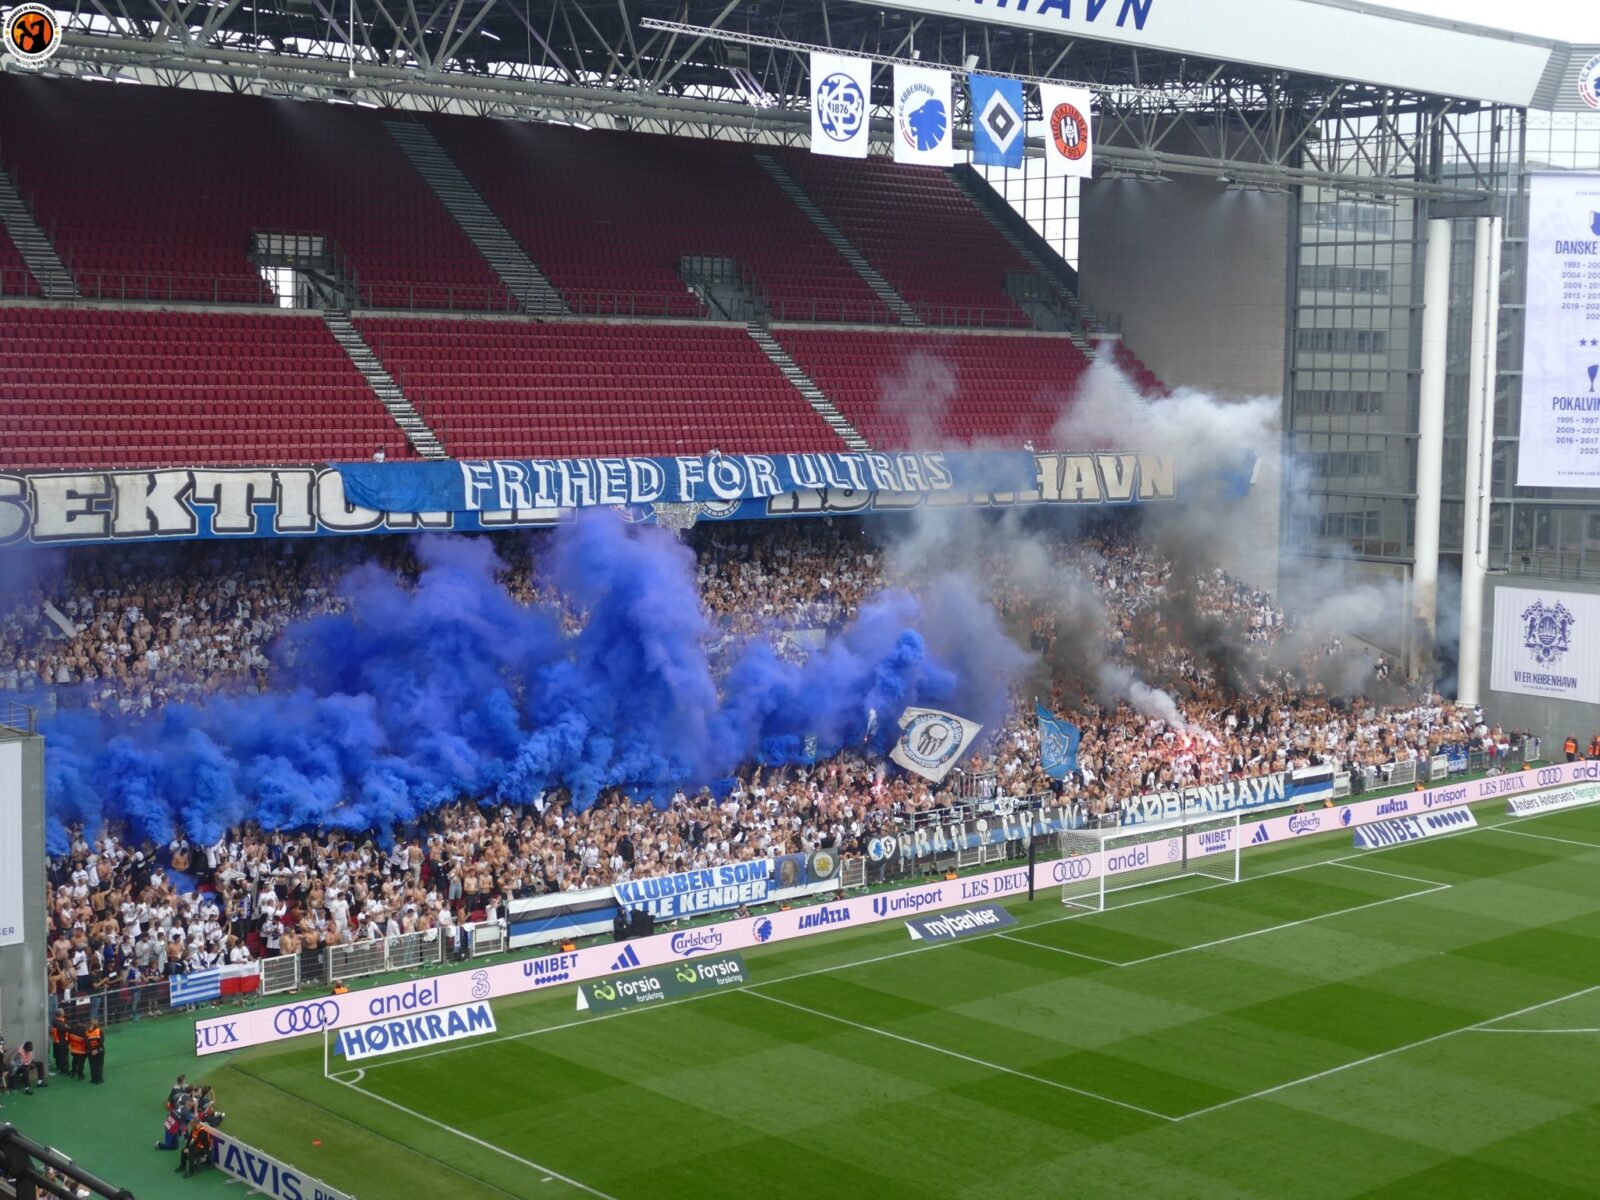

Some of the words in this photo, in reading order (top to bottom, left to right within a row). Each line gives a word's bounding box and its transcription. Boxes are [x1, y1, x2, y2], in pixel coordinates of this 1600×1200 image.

[900, 83, 936, 103] KØBENHAVN
[832, 103, 849, 114] 1876
[1052, 105, 1087, 142] BOLDKLUBBEN
[1064, 146, 1081, 158] 1903
[1555, 240, 1598, 255] DANSKE
[1553, 396, 1600, 411] POKALVI
[460, 456, 665, 511] FRIHED
[675, 454, 784, 502] FOR
[786, 451, 953, 492] ULTRAS
[1514, 670, 1522, 682] VI
[1522, 673, 1532, 683] ER
[1532, 674, 1577, 688] KØBENHAVN
[1573, 762, 1600, 780] and
[1434, 787, 1467, 805] unisport
[1480, 782, 1496, 796] LES
[1500, 775, 1525, 793] DEUX
[1121, 773, 1286, 825] KØBENHAVN
[1376, 798, 1408, 816] LAVAZZA
[1288, 812, 1320, 834] Carlsberg
[1361, 815, 1427, 848] UNIBET
[1199, 829, 1232, 846] UNIBET
[1108, 846, 1149, 872] andel
[615, 869, 714, 903] KLUBBEN
[719, 859, 768, 888] SOM
[961, 880, 989, 900] LES
[993, 872, 1031, 896] DEUX
[679, 880, 767, 912] KENDER
[890, 888, 943, 912] unisport
[798, 906, 850, 930] LAVAZZA
[923, 907, 1000, 938] mybanker
[671, 928, 722, 955] Carlsberg
[523, 953, 578, 977] UNIBET
[697, 959, 740, 981] forsia
[471, 969, 491, 999] 3
[615, 975, 661, 997] forsia
[716, 974, 743, 986] forsikring
[369, 980, 439, 1016] andel
[636, 990, 664, 1004] forsikring
[341, 1004, 493, 1057] HØRKRAM
